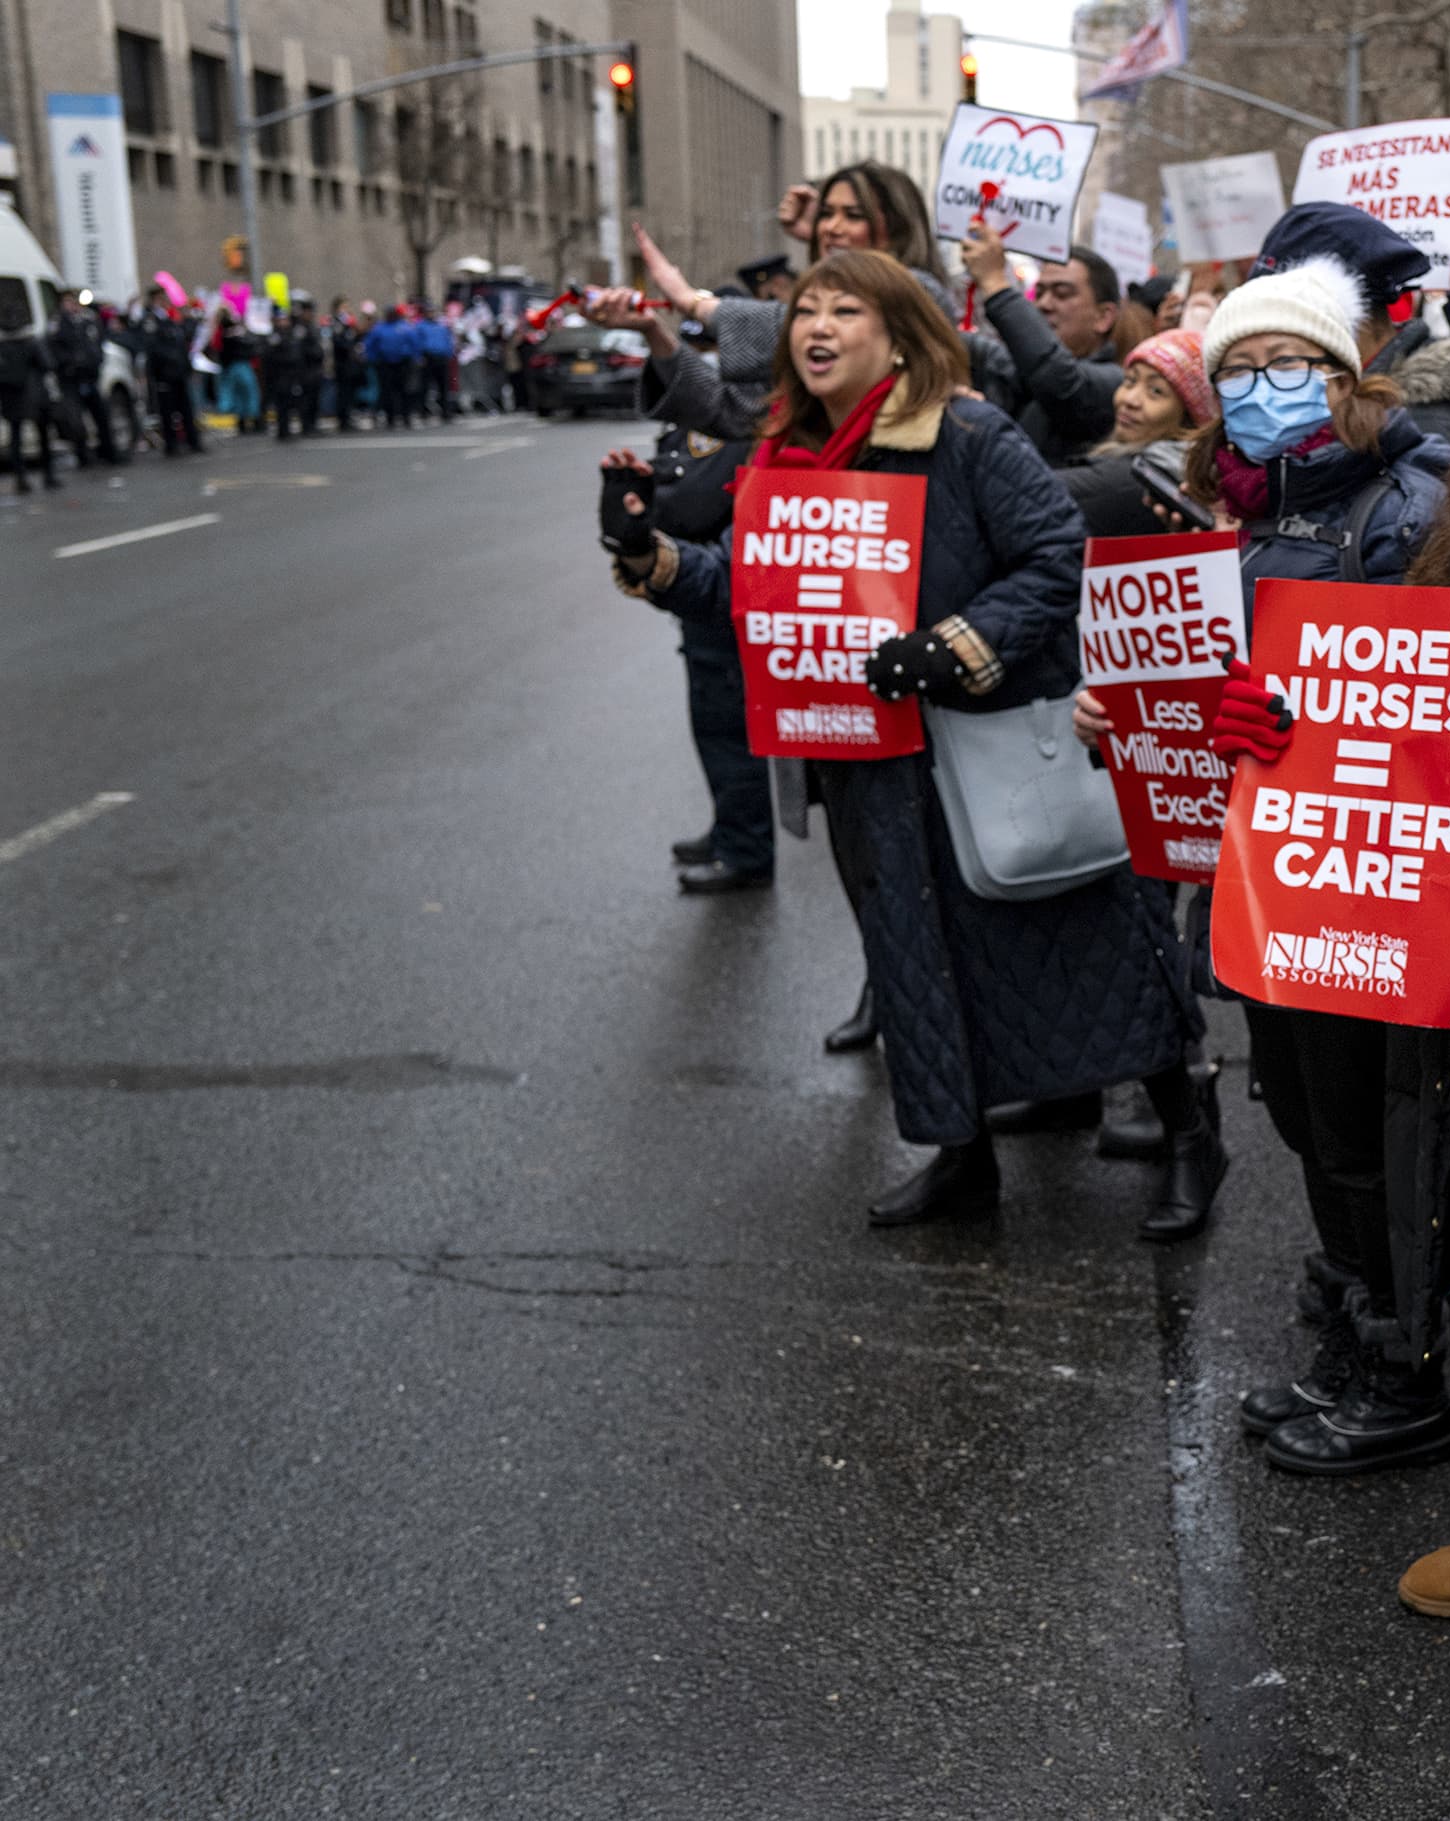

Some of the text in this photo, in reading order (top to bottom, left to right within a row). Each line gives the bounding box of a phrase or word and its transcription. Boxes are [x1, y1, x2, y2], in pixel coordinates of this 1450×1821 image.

[959, 141, 1066, 183] nurses
[1317, 148, 1337, 170] SE
[1347, 161, 1399, 195] MÁS
[769, 496, 889, 534] MORE
[743, 532, 911, 573] NURSES
[1088, 566, 1203, 622] MORE
[746, 611, 899, 649] BETTER
[1083, 616, 1237, 674] NURSES
[767, 647, 868, 684] CARE
[1134, 688, 1203, 732] Less
[1273, 840, 1425, 902] CARE
[1264, 931, 1408, 982] NURSES
[1319, 925, 1409, 950] New York State
[1260, 964, 1407, 998] ASSOCIATION
